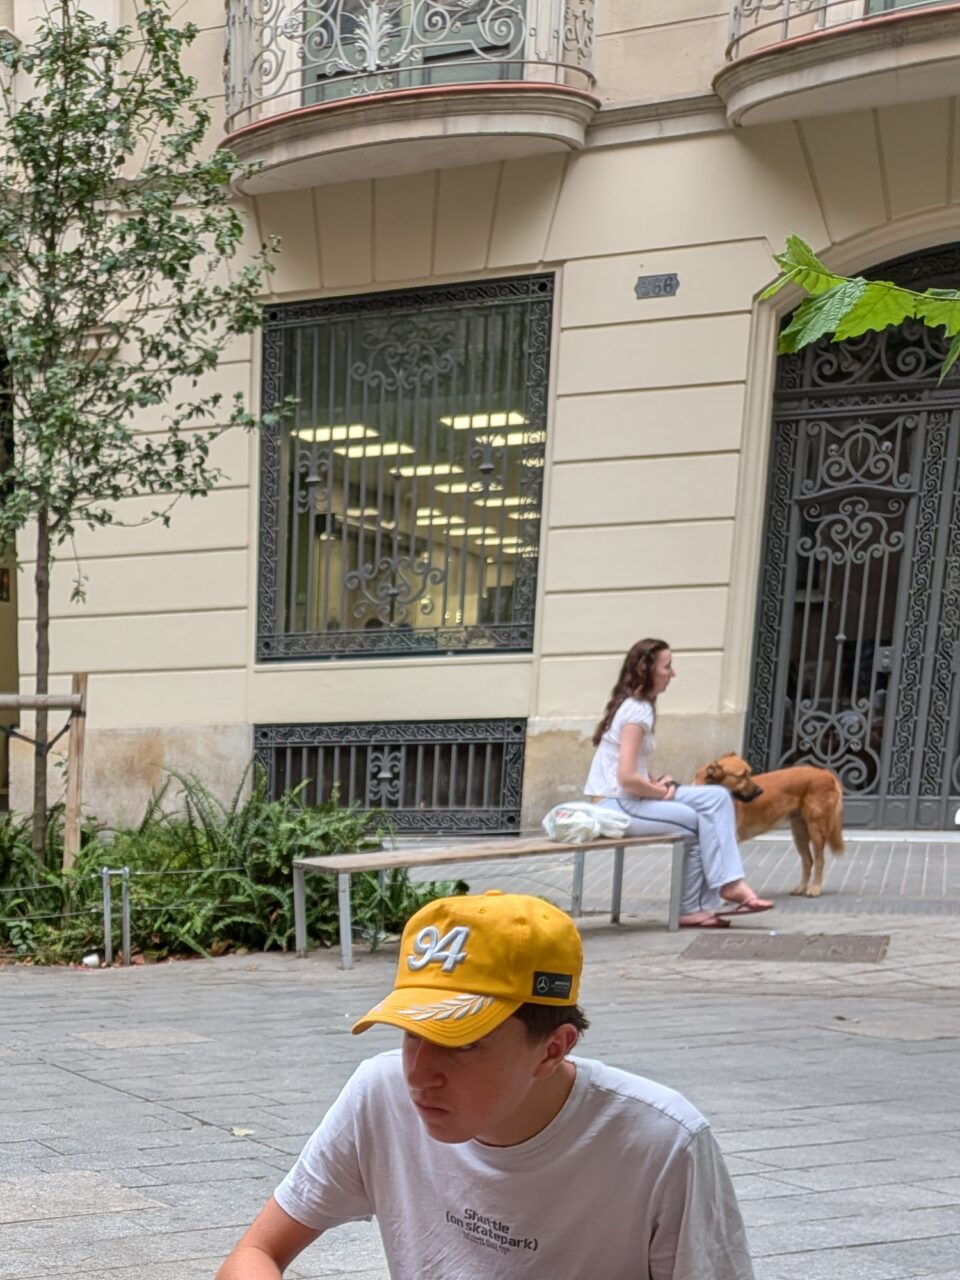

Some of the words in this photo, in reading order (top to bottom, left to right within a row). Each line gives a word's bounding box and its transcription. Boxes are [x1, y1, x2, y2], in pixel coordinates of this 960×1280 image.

[407, 925, 470, 973] 94
[446, 1210, 464, 1228] (on
[465, 1222, 538, 1251] skatepark)
[464, 1208, 510, 1234] Shuttle
